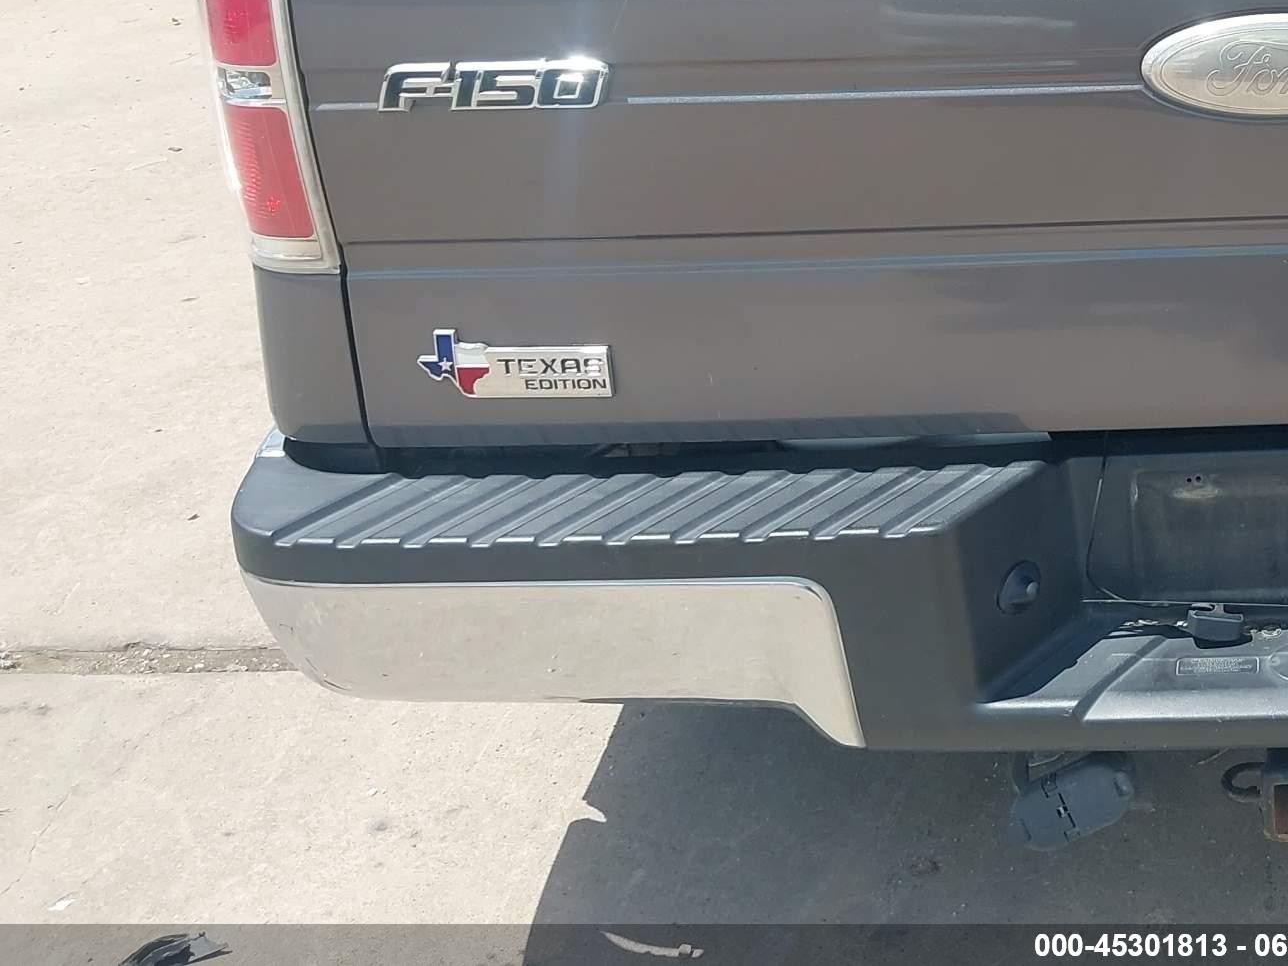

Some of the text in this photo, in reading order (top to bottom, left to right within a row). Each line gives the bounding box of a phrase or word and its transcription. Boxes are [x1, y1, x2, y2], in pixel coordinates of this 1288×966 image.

[377, 58, 609, 112] F-150
[496, 358, 604, 376] TEXAS
[525, 378, 608, 391] EDITION
